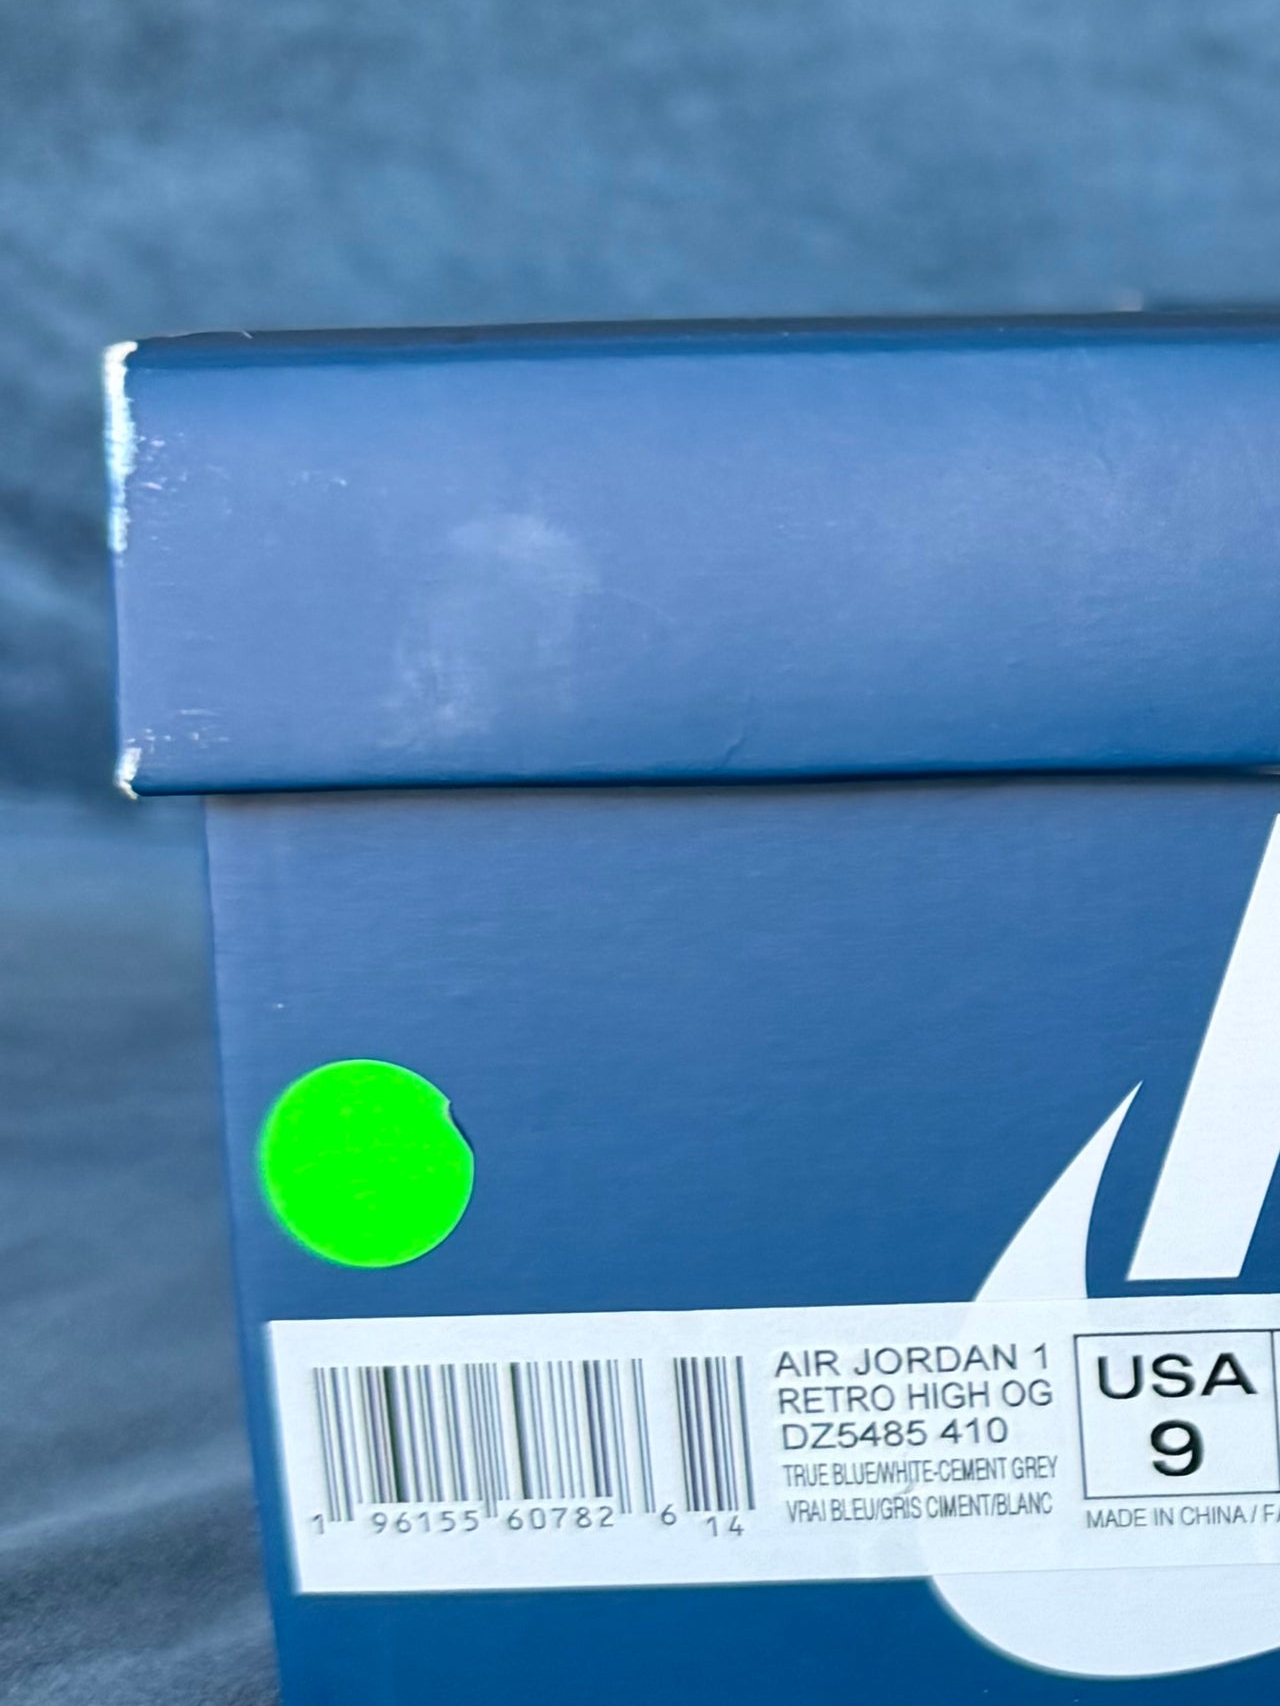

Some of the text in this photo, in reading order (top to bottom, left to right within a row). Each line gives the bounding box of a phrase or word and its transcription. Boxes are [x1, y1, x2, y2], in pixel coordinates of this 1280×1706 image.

[775, 1342, 1048, 1377] AIR JORDAN 1
[1096, 1351, 1257, 1399] USA
[778, 1379, 1053, 1414] RETRO HIGH OG
[782, 1417, 1008, 1450] DZ5485 410
[1150, 1419, 1205, 1477] 9
[783, 1455, 1058, 1487] TRUE BLUE/WHITE-CEMENT GREY
[312, 1505, 745, 1537] 1 96155 60782 6 14
[786, 1492, 1053, 1523] VRAI BLEU/GRIS CIMENT/BLANC
[1086, 1509, 1148, 1528] MADE
[1154, 1508, 1175, 1527] IN
[1180, 1505, 1247, 1526] CHINA
[1249, 1505, 1258, 1524] /
